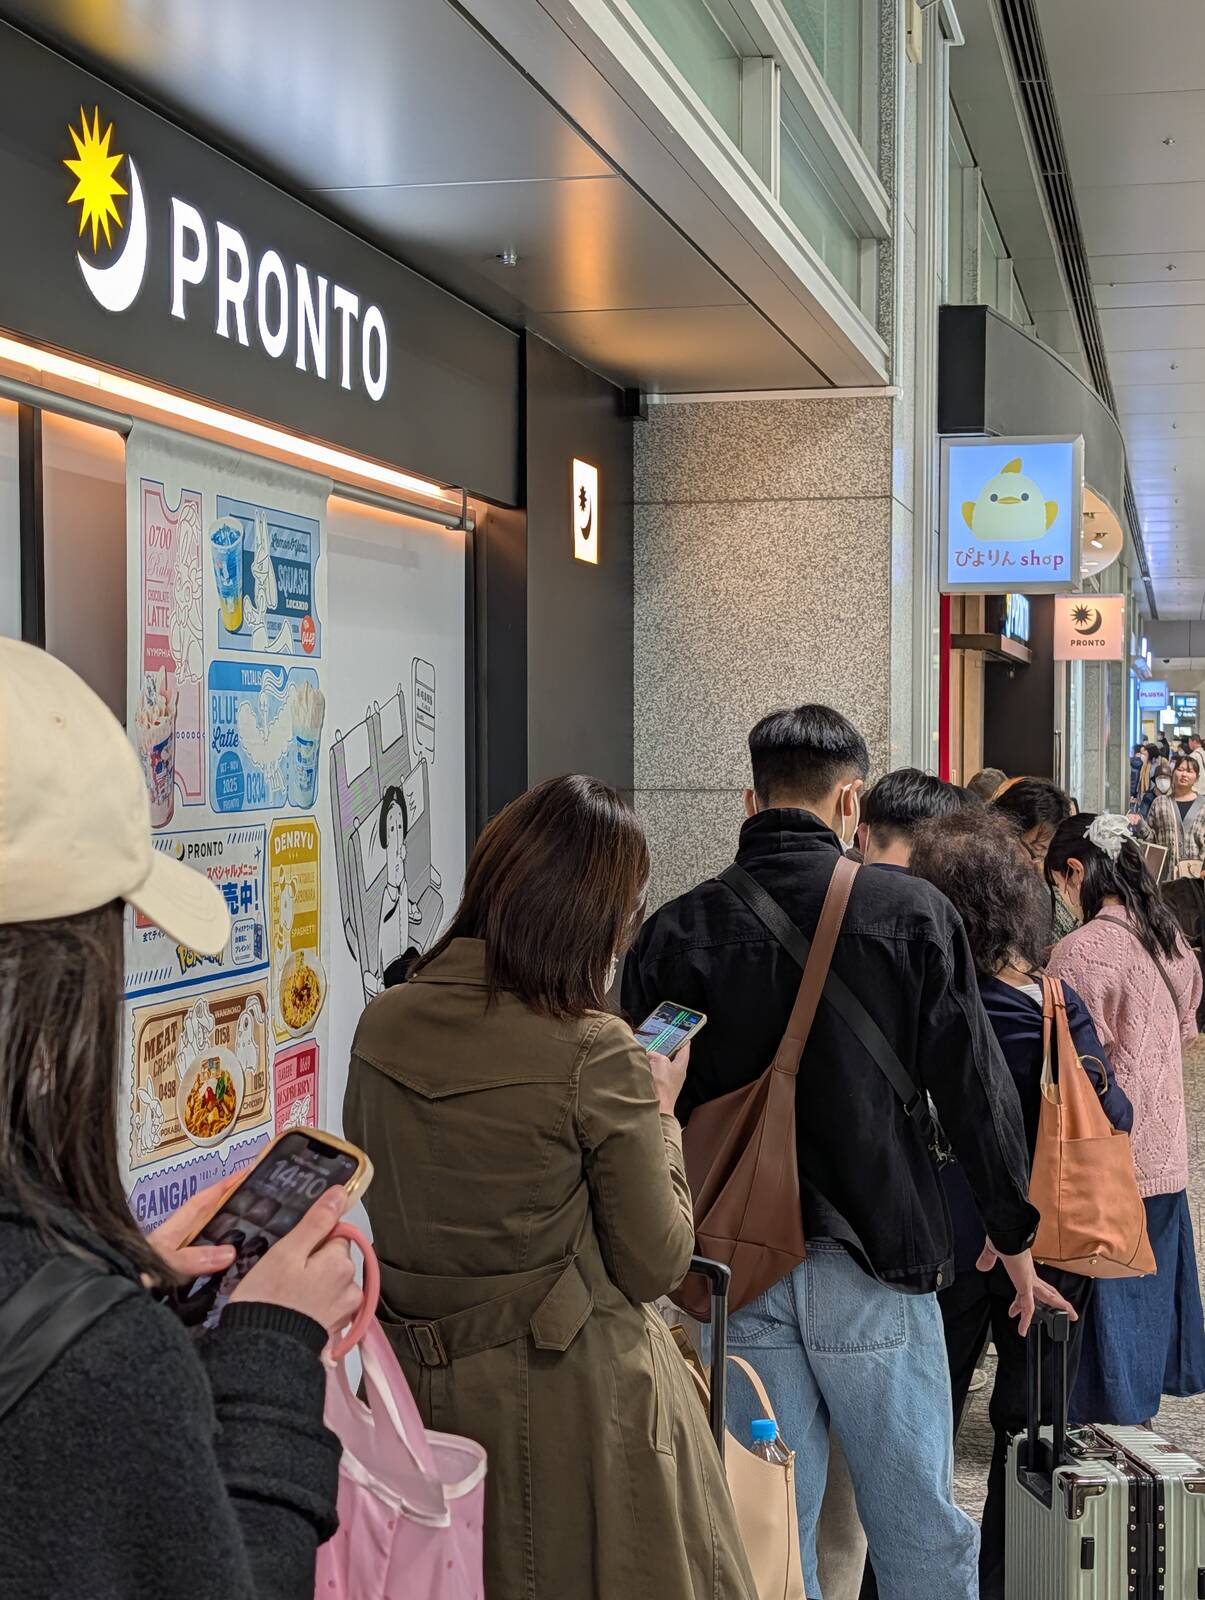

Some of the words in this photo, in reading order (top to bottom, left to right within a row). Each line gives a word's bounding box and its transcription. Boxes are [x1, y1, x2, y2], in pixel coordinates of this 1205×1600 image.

[170, 196, 388, 401] PRONTO
[149, 525, 172, 550] 0700
[955, 547, 1016, 567] ぴよりん
[1020, 551, 1064, 570] shop
[278, 564, 309, 597] SQUASH
[147, 603, 170, 628] LATTE
[1070, 639, 1106, 647] PRONTO
[212, 726, 239, 753] Latte
[187, 841, 223, 859] PRONTO
[274, 830, 314, 854] DENRYU
[207, 864, 257, 880] スペシャルメニュー
[216, 879, 259, 915] 売中!
[144, 1021, 177, 1063] MEAT
[153, 1051, 177, 1078] CREAM
[159, 1080, 176, 1101] 0498
